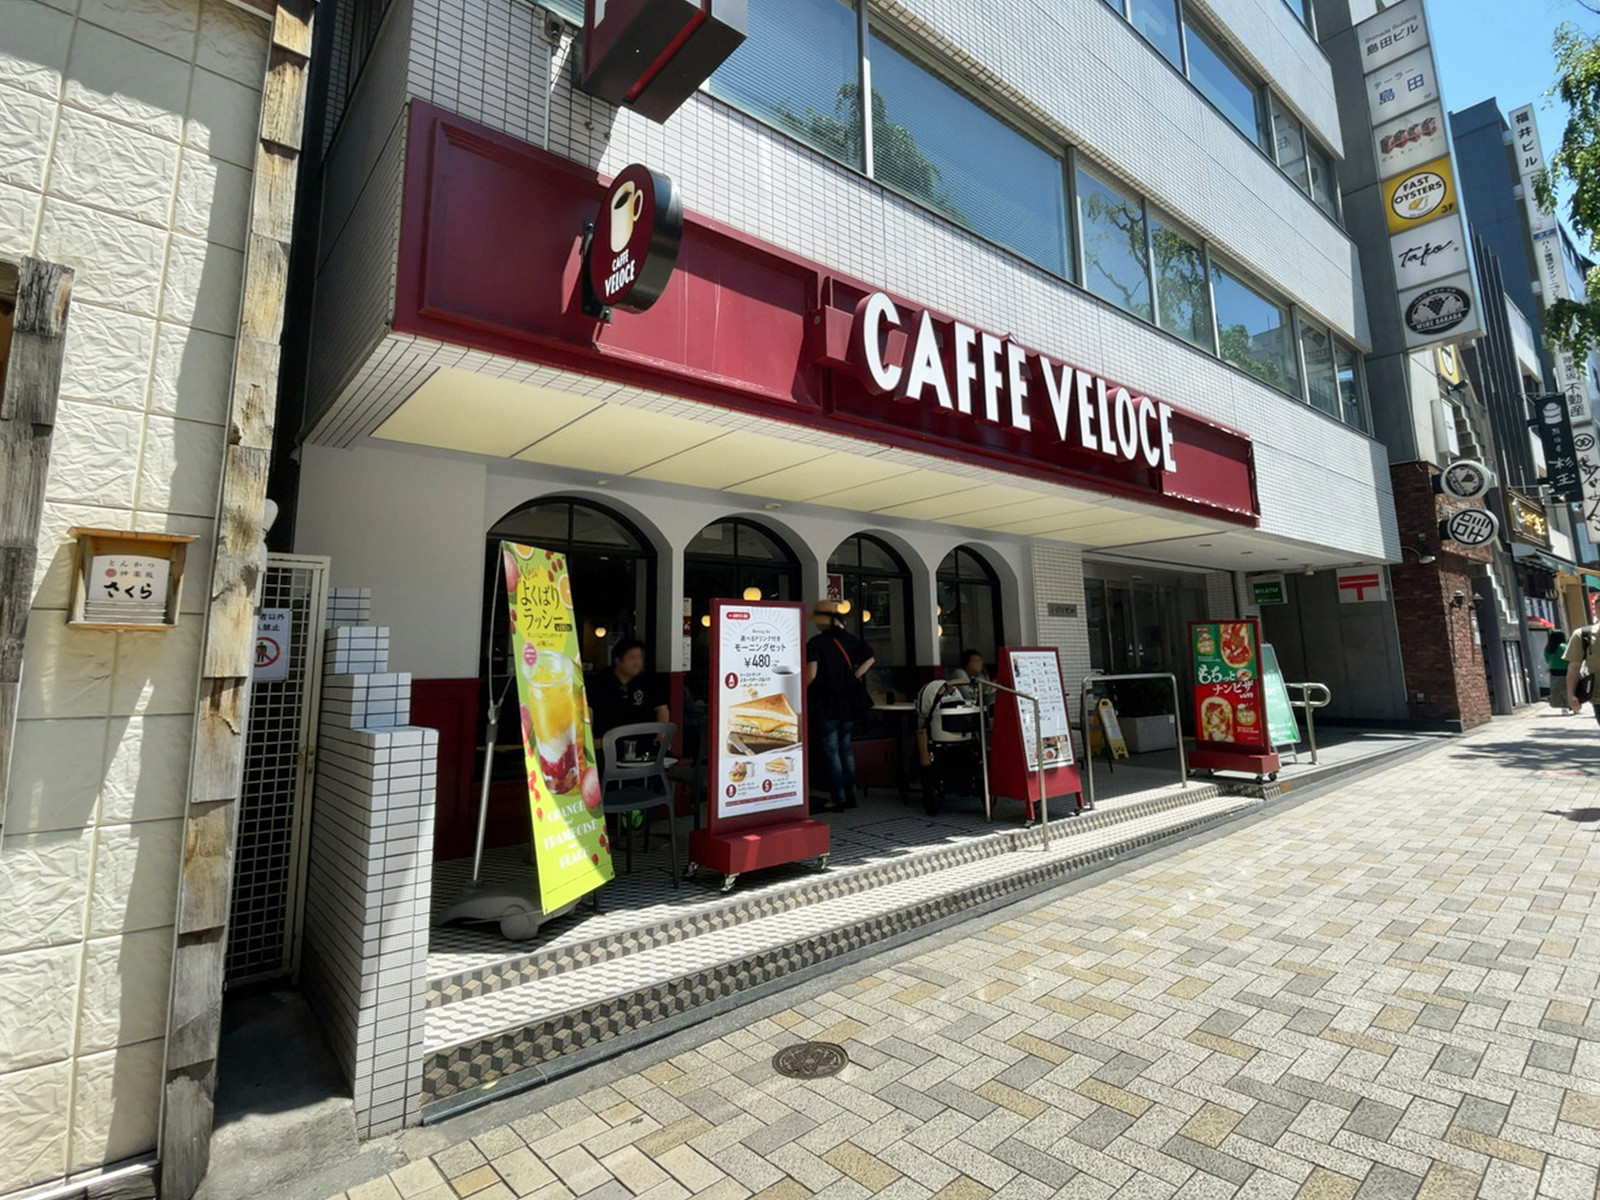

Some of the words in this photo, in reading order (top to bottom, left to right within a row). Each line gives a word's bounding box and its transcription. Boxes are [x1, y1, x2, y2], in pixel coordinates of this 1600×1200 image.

[1366, 24, 1419, 56] 島田ビル
[1515, 111, 1538, 169] 福井ビル
[1394, 180, 1443, 205] OYSTERS
[1403, 175, 1430, 193] FAST
[612, 249, 630, 272] CAFFE
[604, 259, 636, 297] VELOCE
[863, 291, 1032, 433] CAFFE
[1038, 353, 1177, 473] VELOCE
[1565, 383, 1585, 417] 不動産
[1548, 456, 1576, 487] 杉玉
[109, 560, 156, 568] とんかつ
[103, 581, 153, 599] さくら
[520, 580, 561, 611] よくばり
[523, 608, 564, 631] ラッシー
[734, 643, 787, 653] モーニングセット
[743, 653, 771, 669] ¥480
[1197, 664, 1237, 685] もちっと
[1212, 679, 1255, 696] ナンピザ
